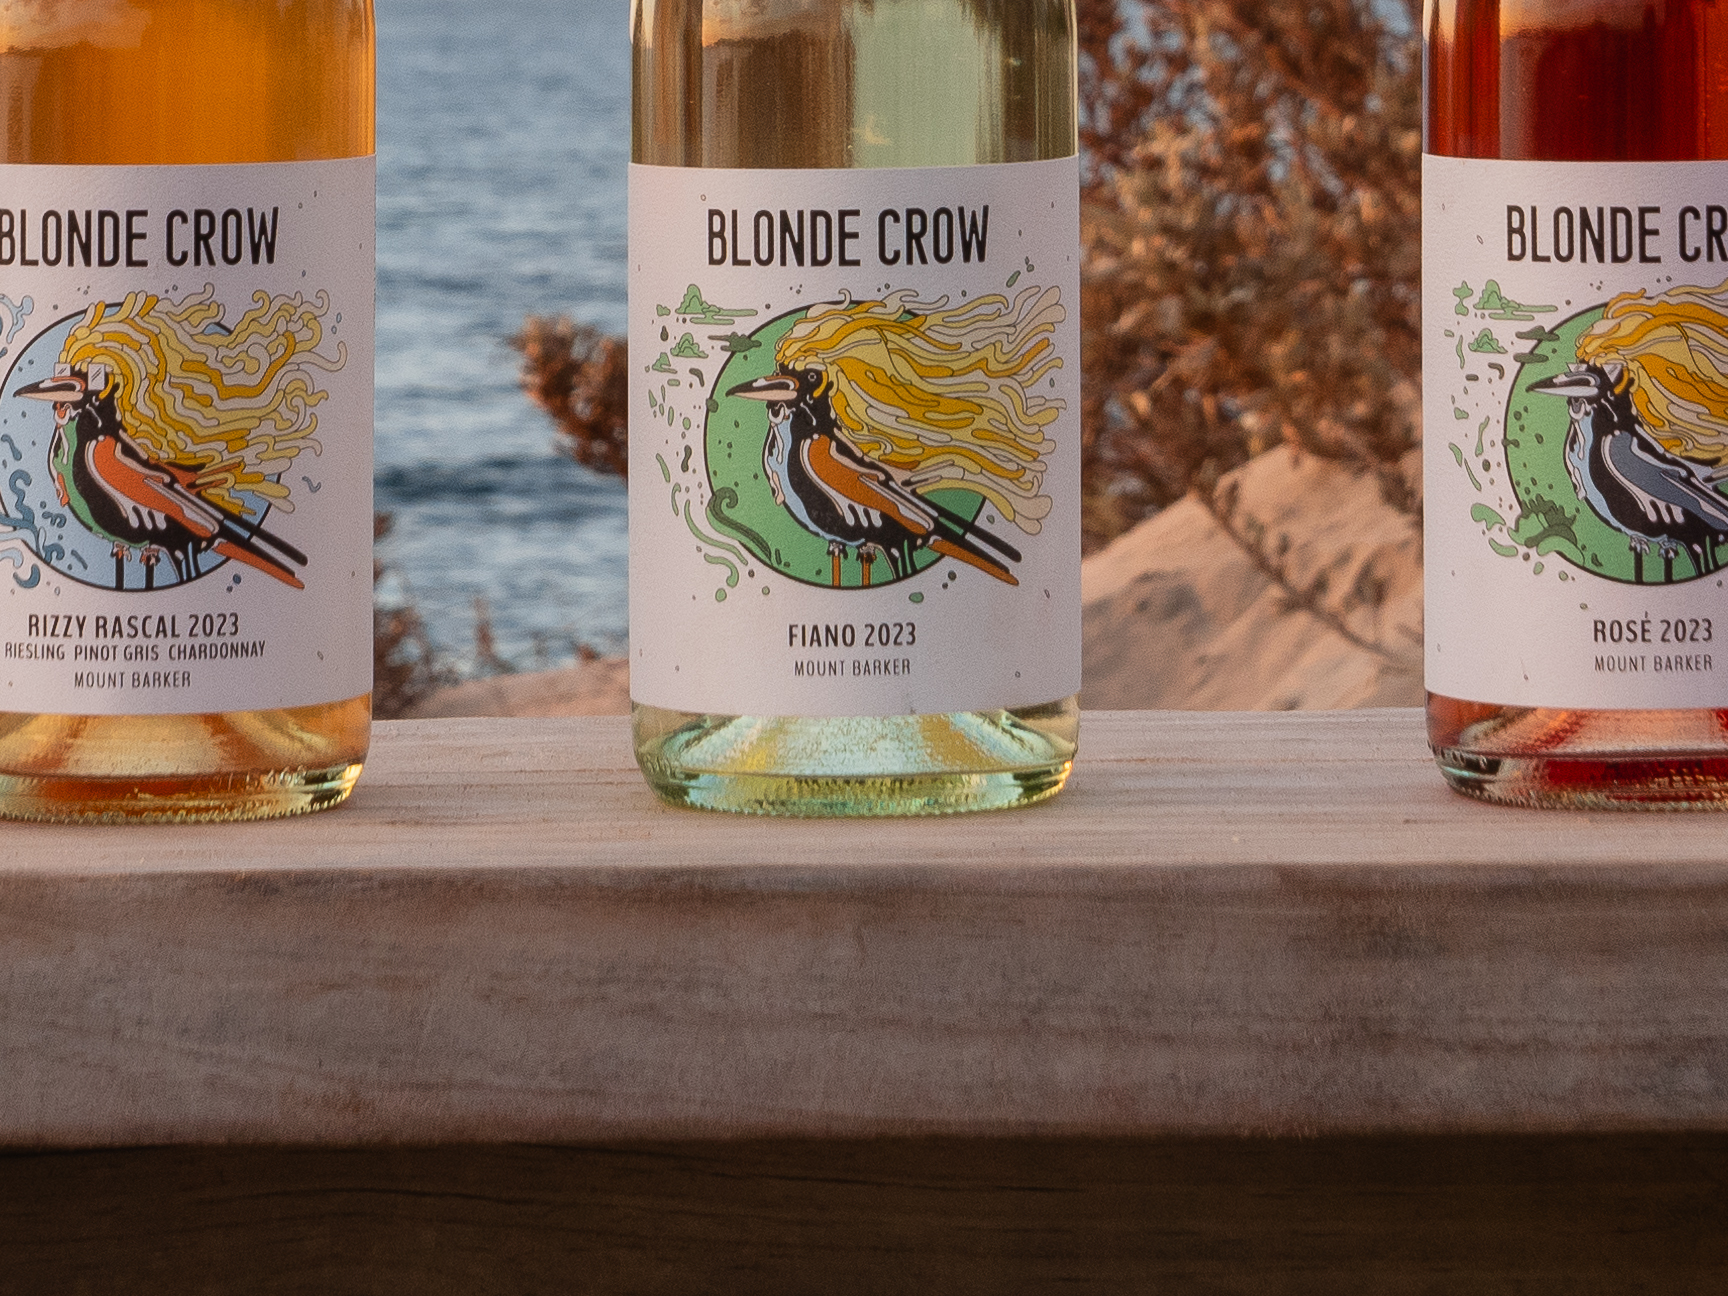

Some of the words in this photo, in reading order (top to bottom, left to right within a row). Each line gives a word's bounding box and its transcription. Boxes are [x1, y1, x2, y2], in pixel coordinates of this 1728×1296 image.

[166, 206, 279, 267] CROW
[708, 208, 861, 267] BLONDE
[878, 204, 989, 266] CROW
[1507, 205, 1662, 264] BLONDE
[28, 614, 87, 639] RIZZY
[95, 614, 181, 639] RASCAL
[188, 612, 239, 638] 2023
[788, 623, 856, 648] FIANO
[864, 621, 916, 647] 2023
[1593, 611, 1652, 644] ROSÉ
[1660, 617, 1713, 643] 2023
[4, 642, 66, 661] RIESLING
[74, 644, 118, 662] PINOT
[123, 644, 160, 662] GRIS
[168, 640, 266, 661] CHARDONNAY
[1594, 655, 1646, 673] MOUNT
[1653, 654, 1713, 672] BARKER
[74, 671, 125, 689] MOUNT
[131, 670, 191, 688] BARKER
[794, 659, 845, 677] MOUNT
[852, 658, 911, 676] BARKER
